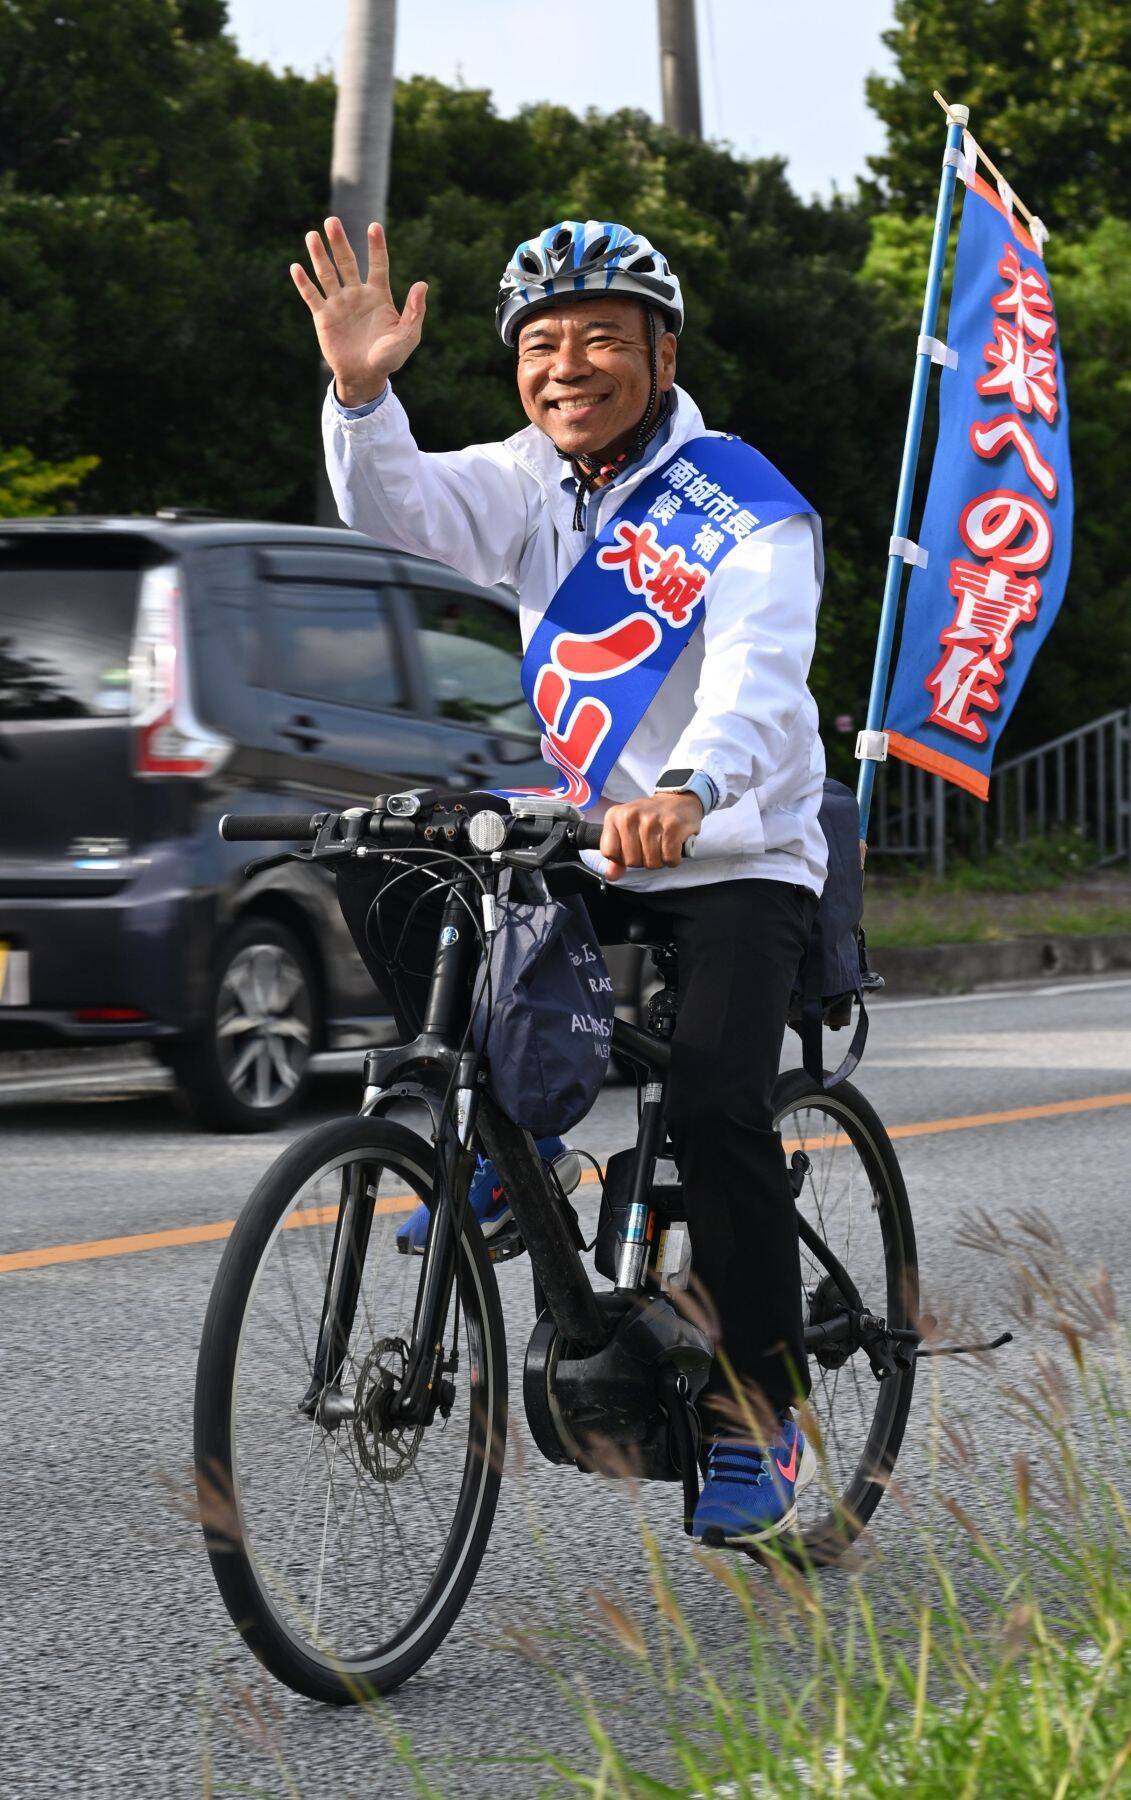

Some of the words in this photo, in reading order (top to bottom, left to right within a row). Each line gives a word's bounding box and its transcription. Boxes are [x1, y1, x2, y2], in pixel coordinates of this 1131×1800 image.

[648, 489, 725, 562] 候補
[661, 457, 761, 543] 南城市長
[924, 242, 1058, 744] 未来への責任
[597, 521, 711, 628] 大城
